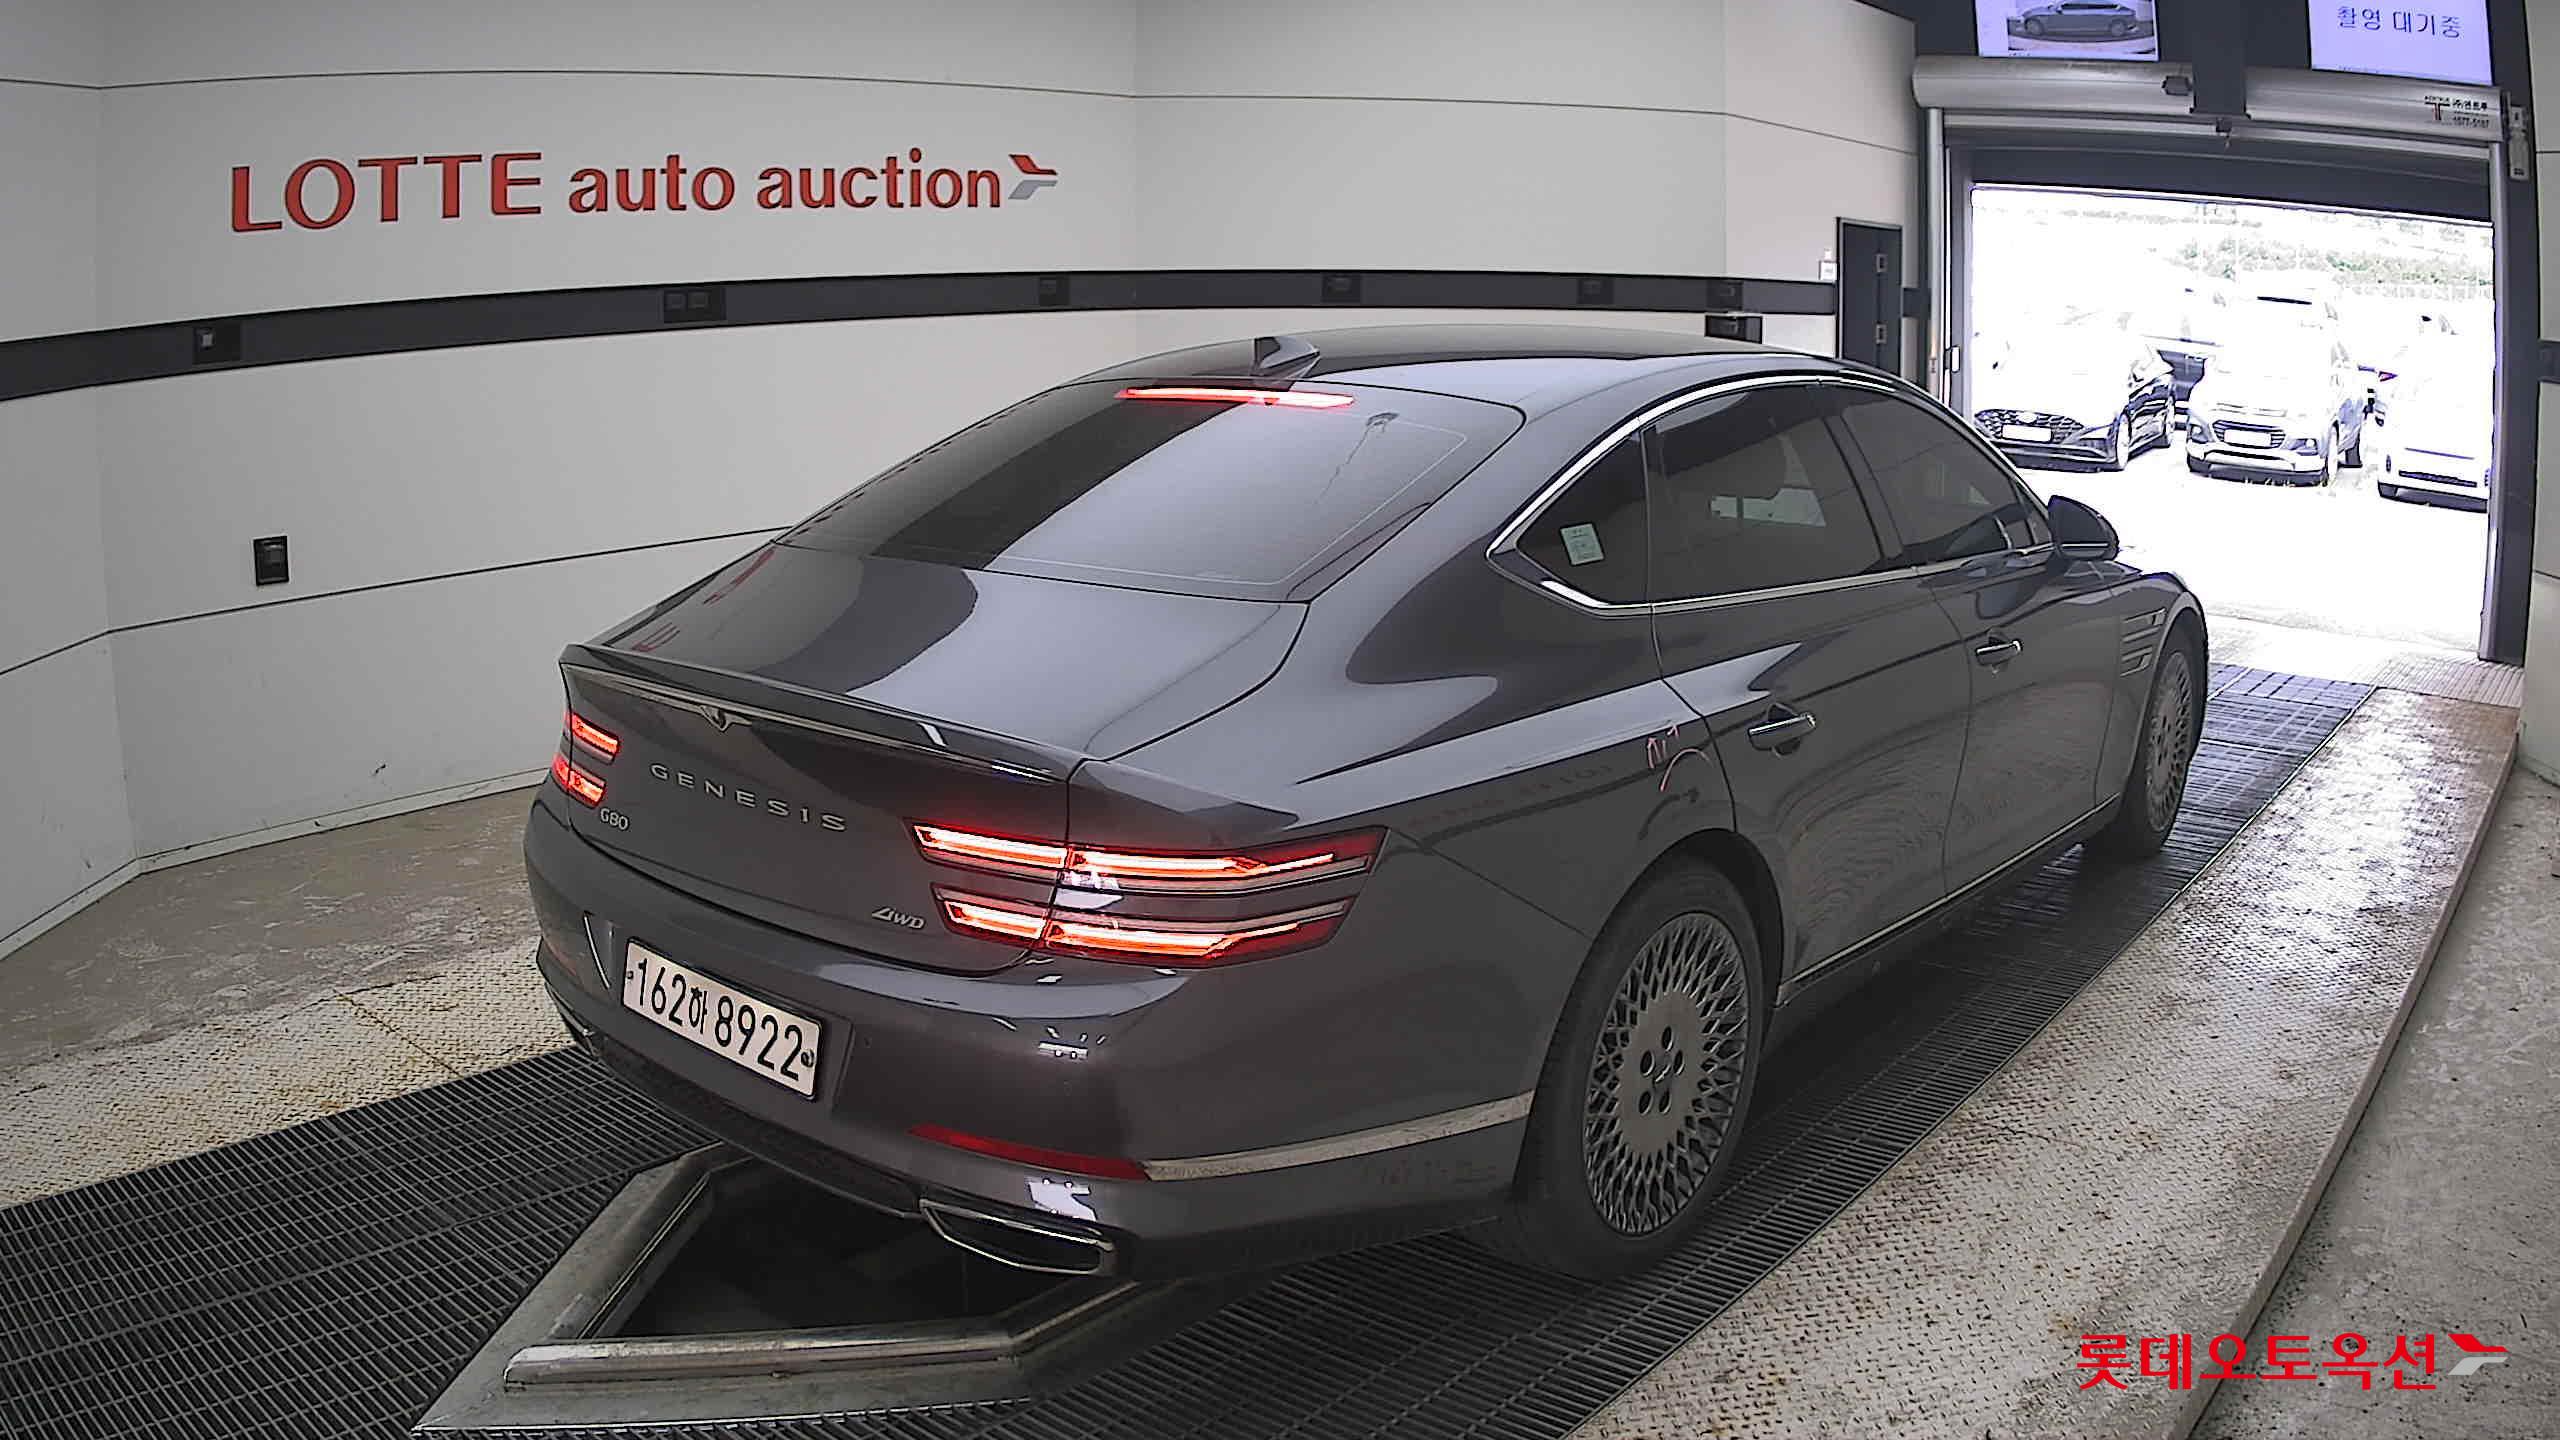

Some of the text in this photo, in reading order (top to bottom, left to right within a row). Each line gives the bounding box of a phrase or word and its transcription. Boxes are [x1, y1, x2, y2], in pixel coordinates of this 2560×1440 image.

[2337, 6, 2462, 39] 촬영 대기중
[231, 147, 1001, 232] LOTTE auto auction
[600, 807, 629, 831] G80
[650, 763, 848, 832] GENESIS
[638, 958, 803, 1082] 162하 8922
